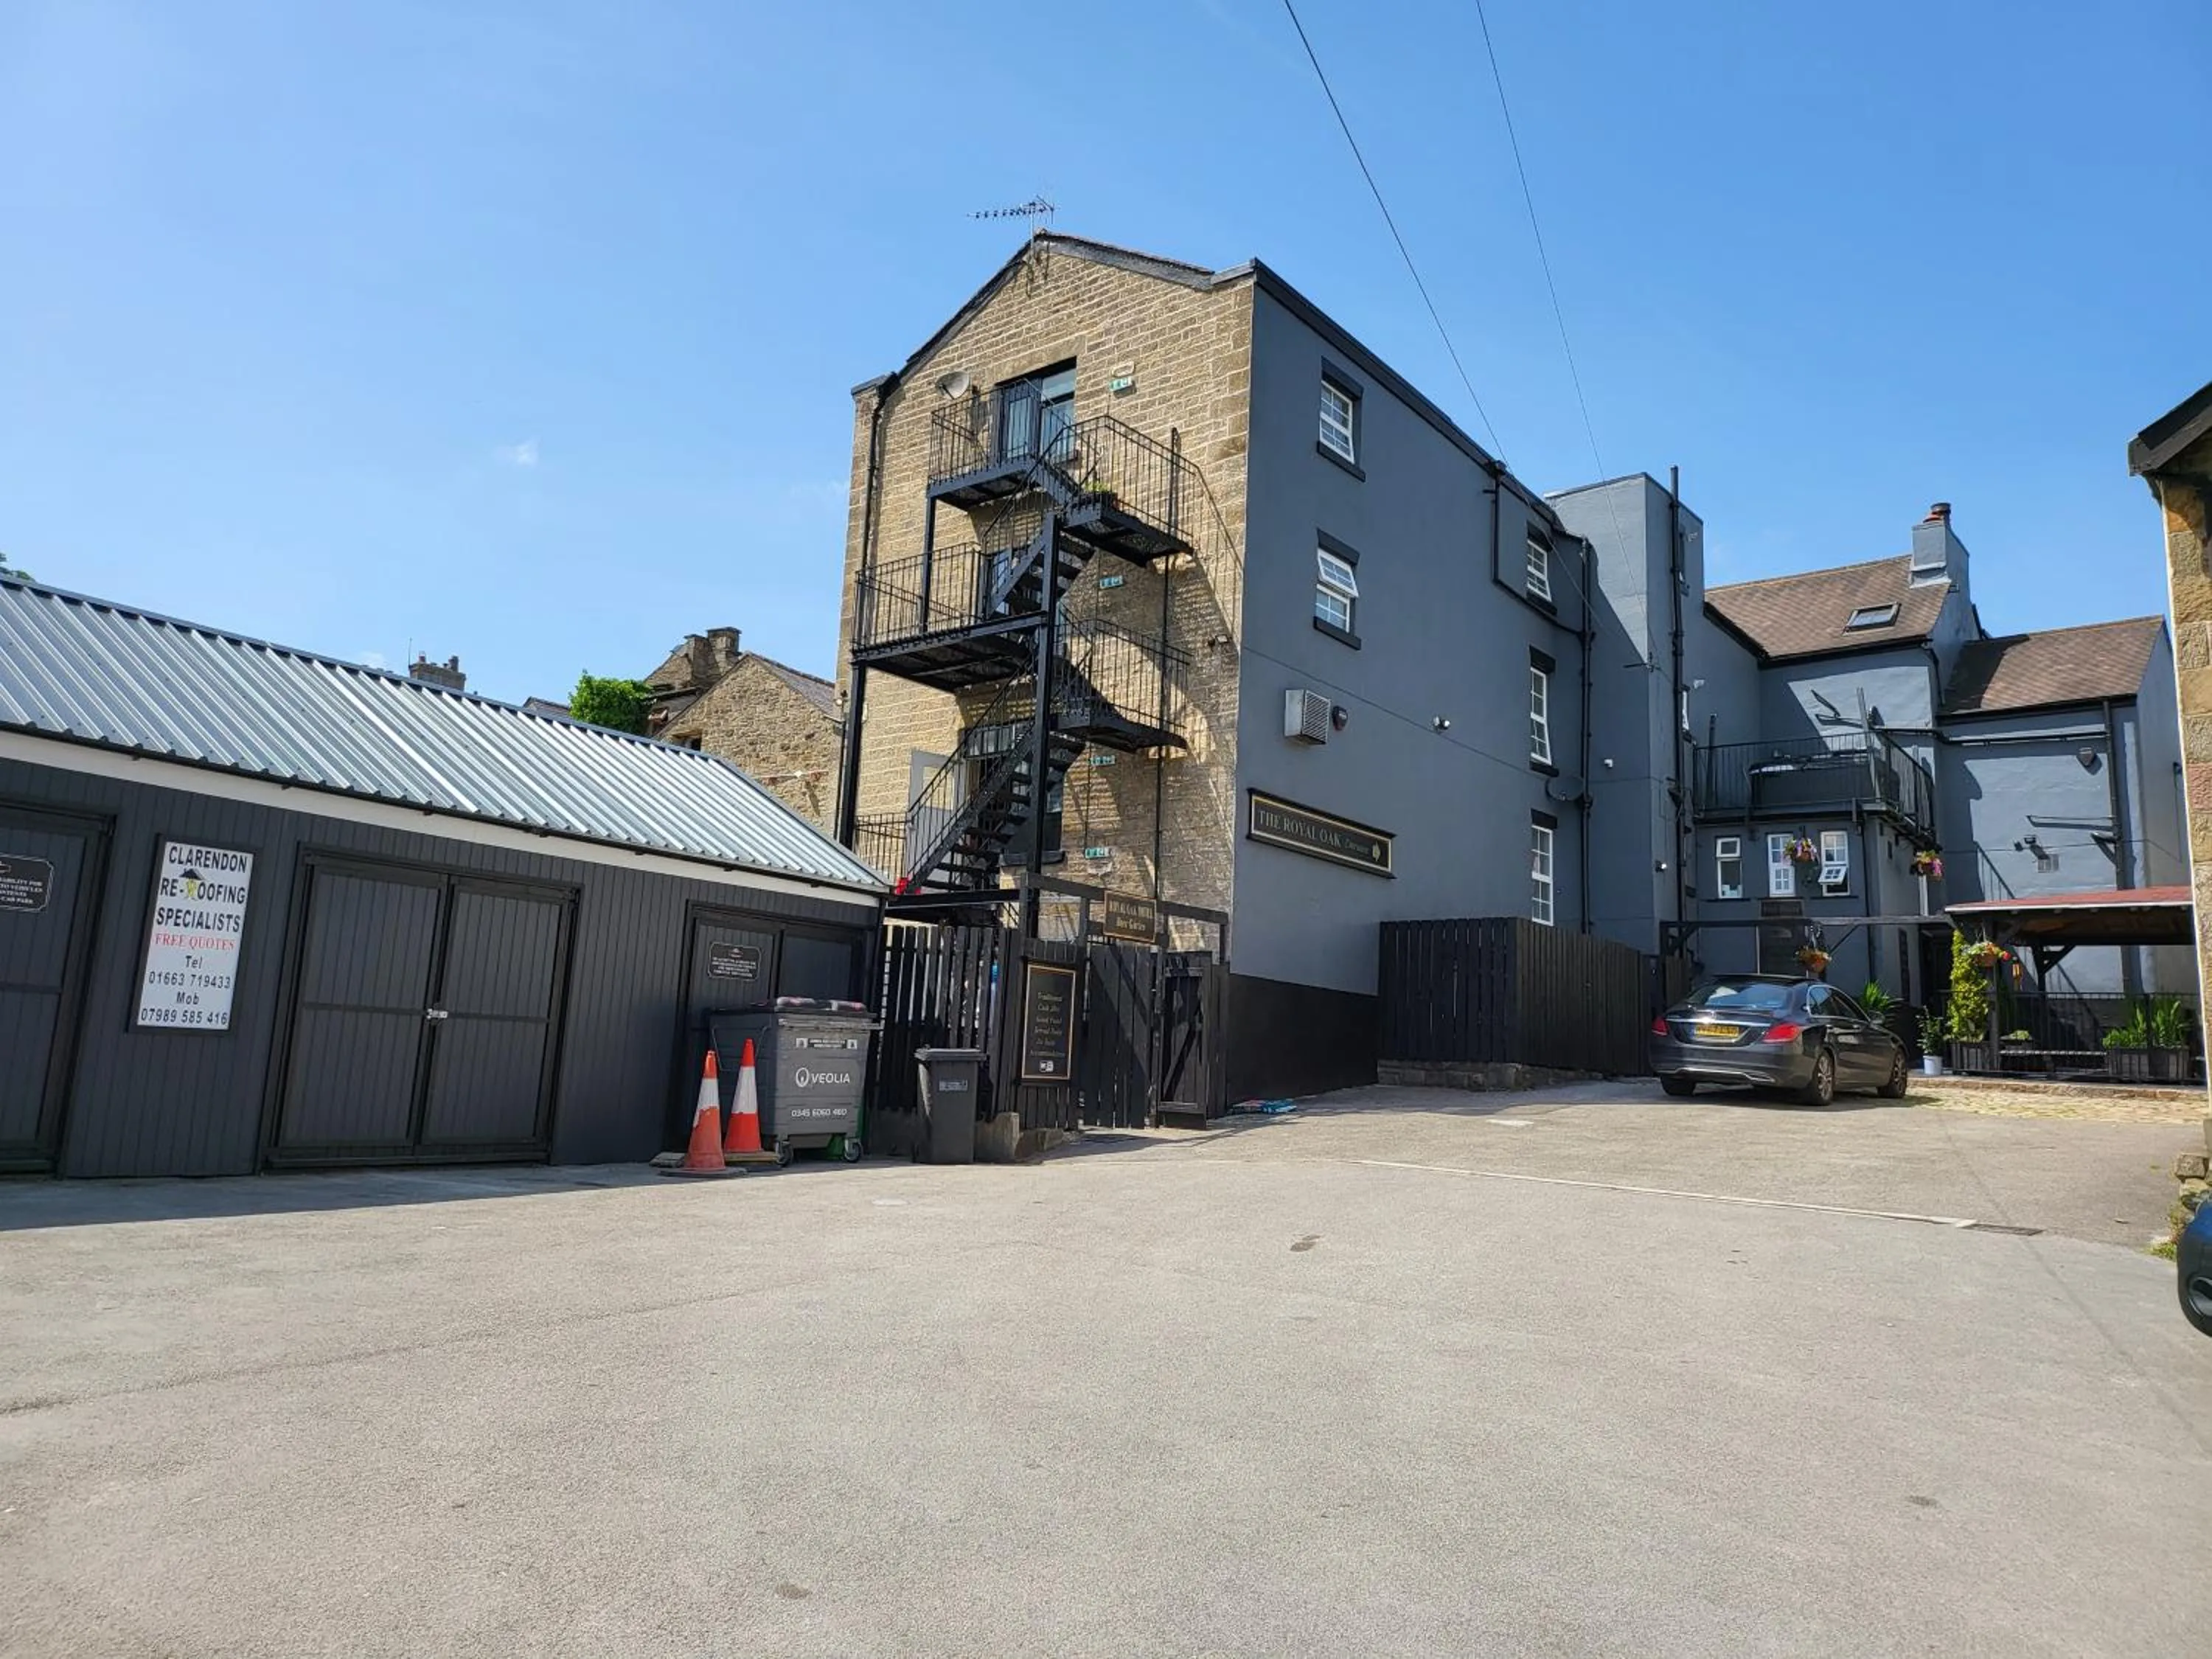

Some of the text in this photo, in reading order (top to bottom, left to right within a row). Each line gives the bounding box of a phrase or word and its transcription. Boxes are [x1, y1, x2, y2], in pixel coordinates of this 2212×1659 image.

[1258, 810, 1281, 829] THE
[1283, 815, 1317, 839] ROYAL
[1319, 828, 1341, 847] OAK
[169, 846, 248, 873] CLARENDON
[156, 907, 241, 933] SPECIALISTS
[155, 933, 234, 950] FREE QUOTES
[185, 956, 203, 969] Tel
[148, 971, 231, 989] 01663 719433
[176, 991, 200, 1005] Mob
[141, 1008, 227, 1025] 07989 585 416
[811, 1073, 850, 1084] VEOLIA
